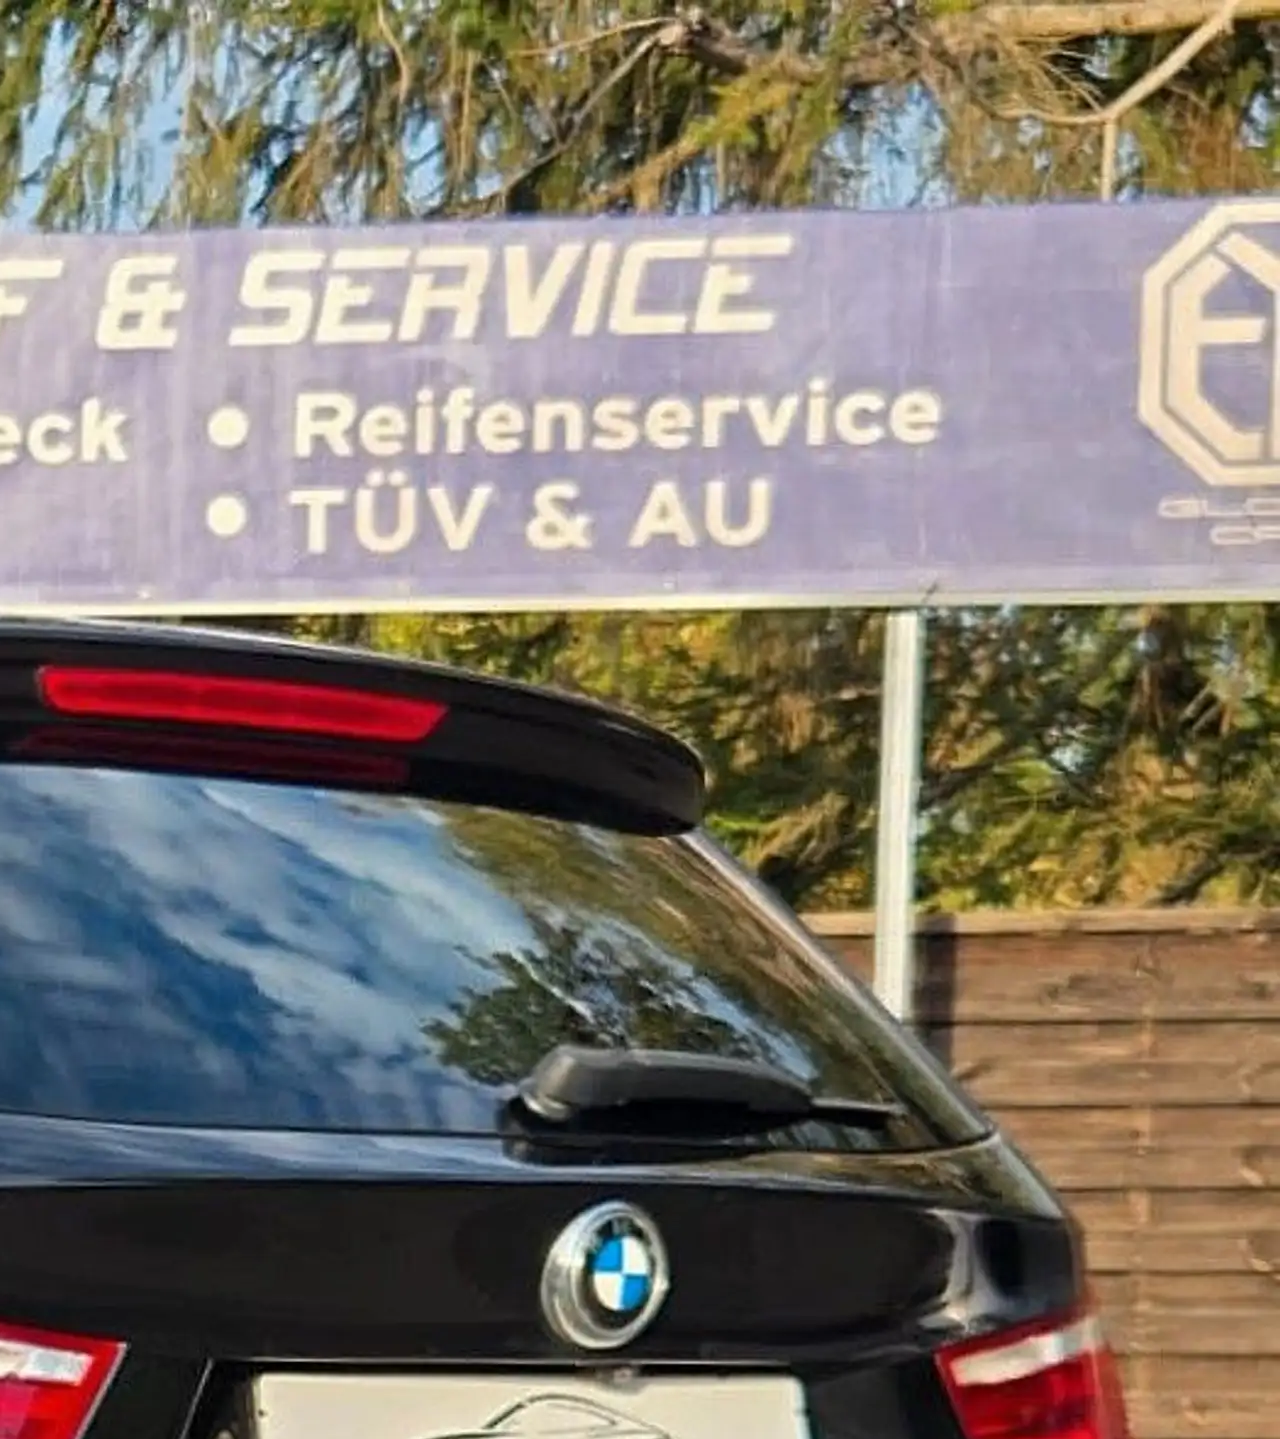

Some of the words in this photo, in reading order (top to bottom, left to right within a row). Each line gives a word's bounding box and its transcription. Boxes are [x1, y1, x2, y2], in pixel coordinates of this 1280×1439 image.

[95, 256, 185, 349] &
[231, 235, 793, 346] SERVICE
[296, 381, 941, 457] Reifenservice
[290, 474, 493, 551] TÜV
[527, 483, 593, 548] &
[632, 480, 769, 546] AU
